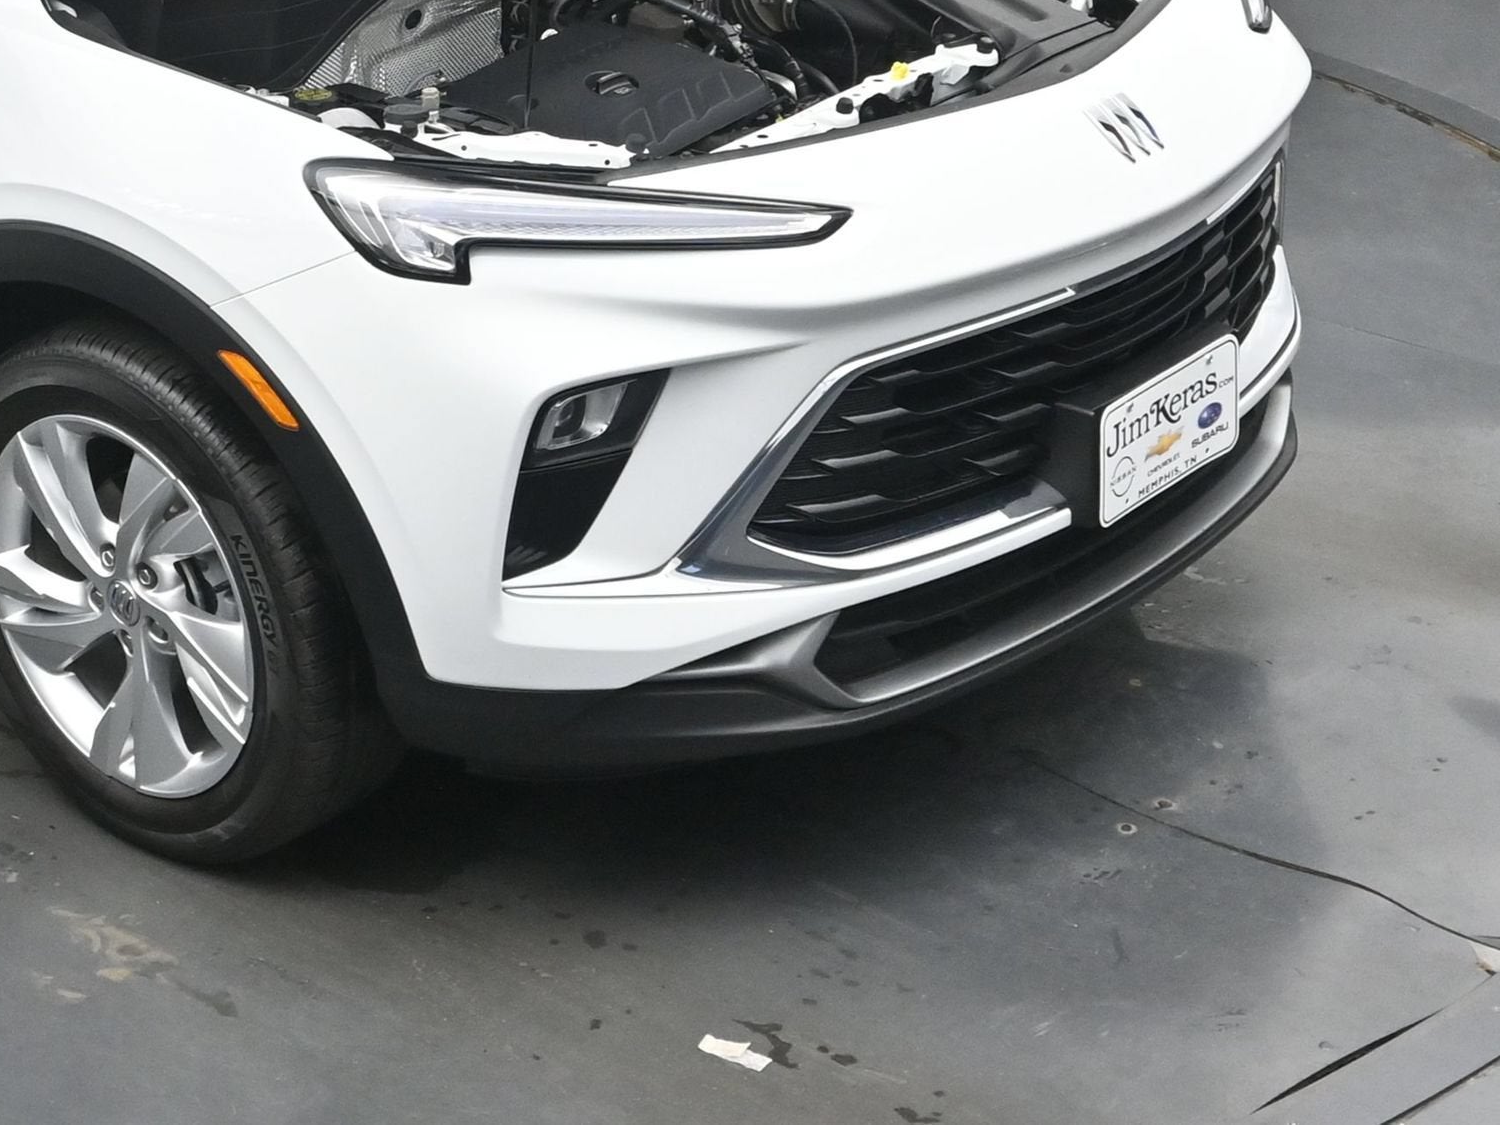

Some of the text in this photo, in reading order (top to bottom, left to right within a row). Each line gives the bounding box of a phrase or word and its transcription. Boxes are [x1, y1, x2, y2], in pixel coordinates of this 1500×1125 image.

[1191, 421, 1229, 448] SUBARU
[1184, 455, 1198, 469] TN
[230, 535, 277, 648] KINERGY
